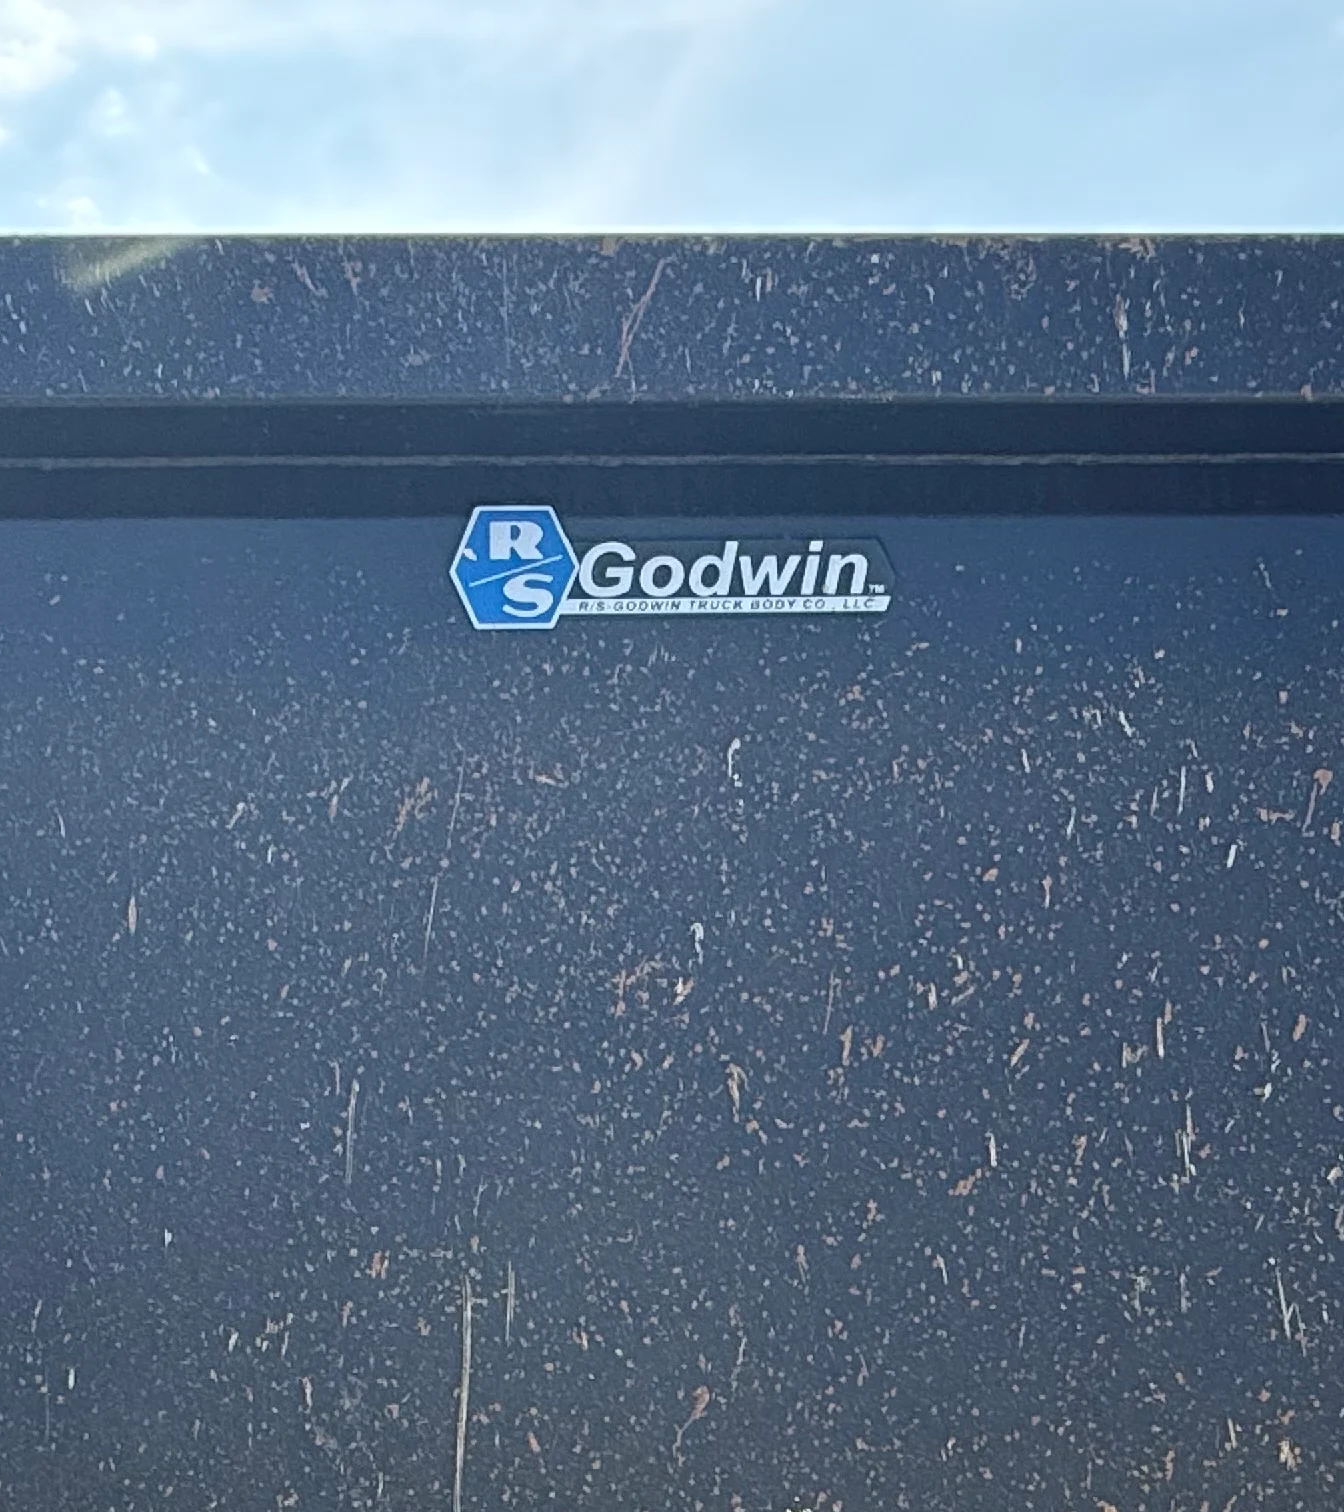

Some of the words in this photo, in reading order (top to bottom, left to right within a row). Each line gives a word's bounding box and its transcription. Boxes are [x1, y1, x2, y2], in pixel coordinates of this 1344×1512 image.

[489, 520, 544, 560] R
[578, 540, 870, 598] Godwin
[501, 573, 554, 618] S
[689, 599, 744, 611] TRUCK
[750, 598, 797, 611] BODY
[842, 597, 876, 610] LLC
